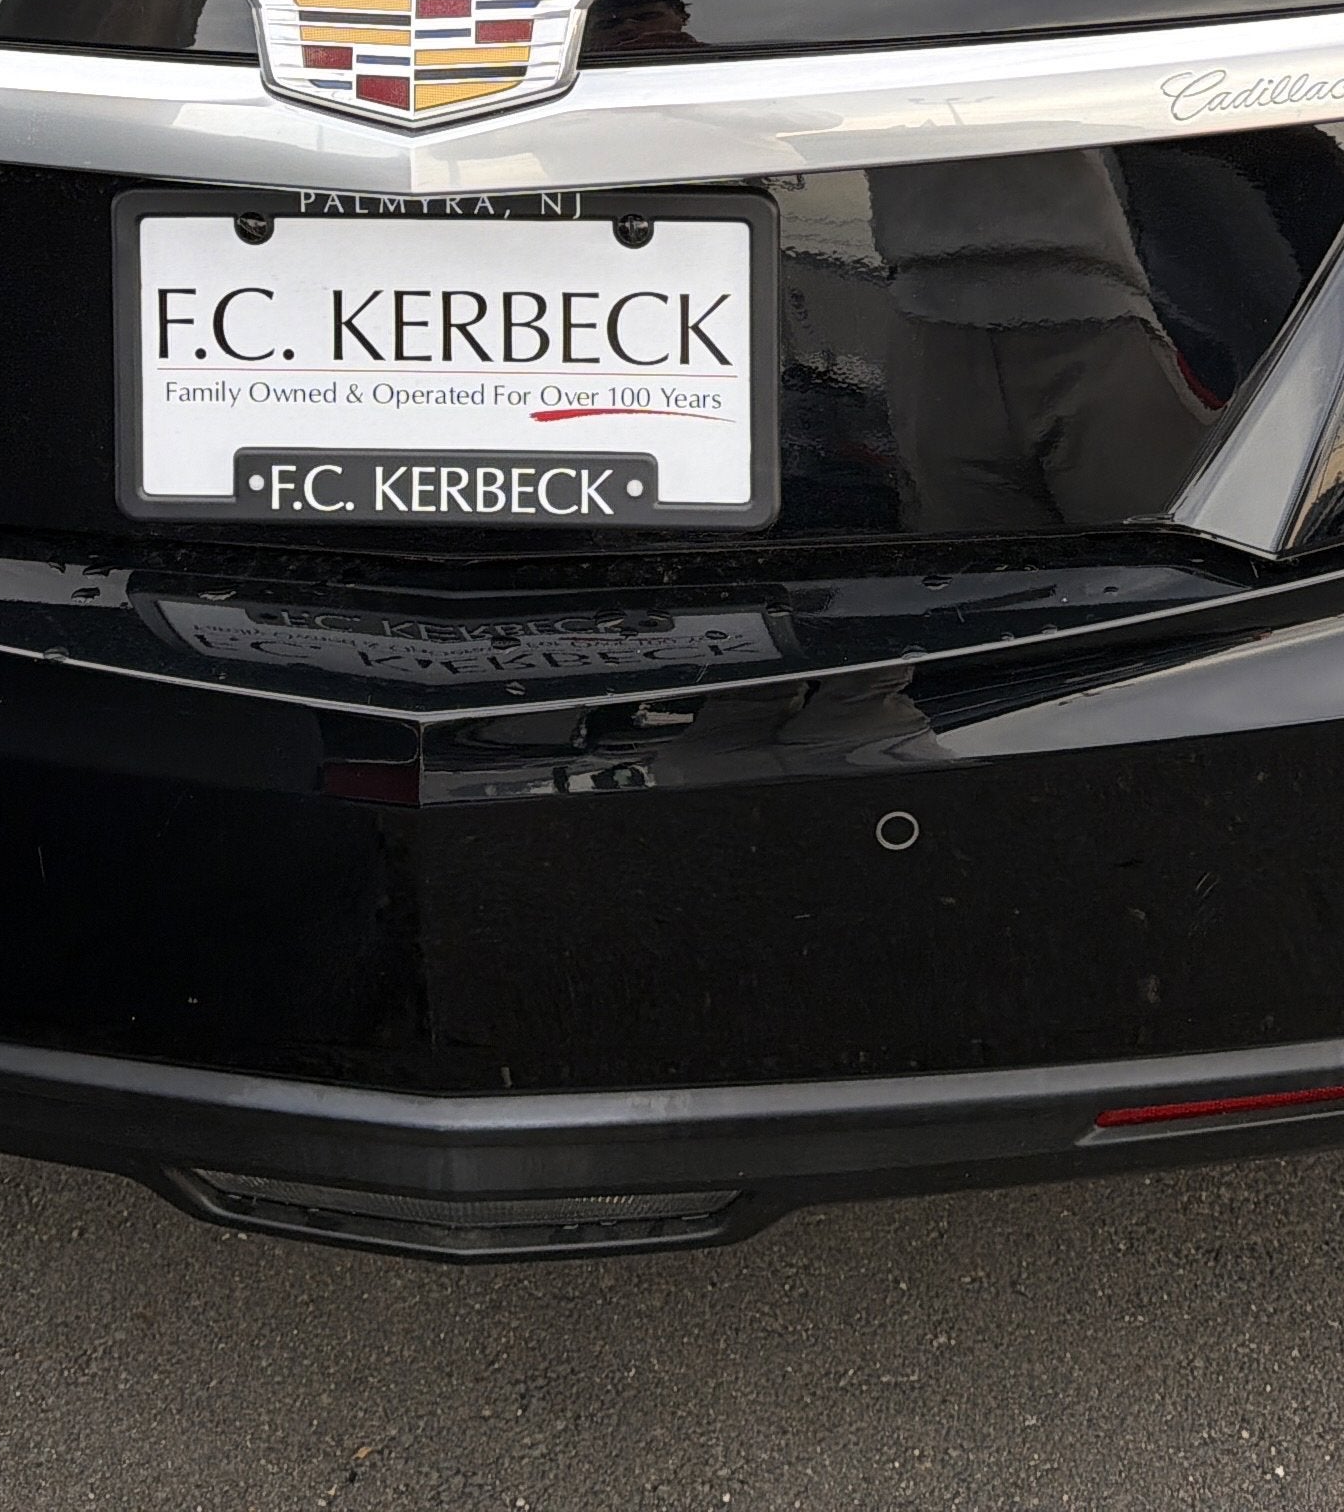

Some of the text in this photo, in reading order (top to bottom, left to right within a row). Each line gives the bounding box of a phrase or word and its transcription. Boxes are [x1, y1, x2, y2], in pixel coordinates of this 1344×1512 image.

[299, 191, 582, 220] PALMYRA, NJ
[157, 287, 734, 366] F.C. KERBECK
[166, 381, 723, 409] Family Owned & Operated For Over 100 Years
[271, 465, 614, 515] F.C. KERBECK
